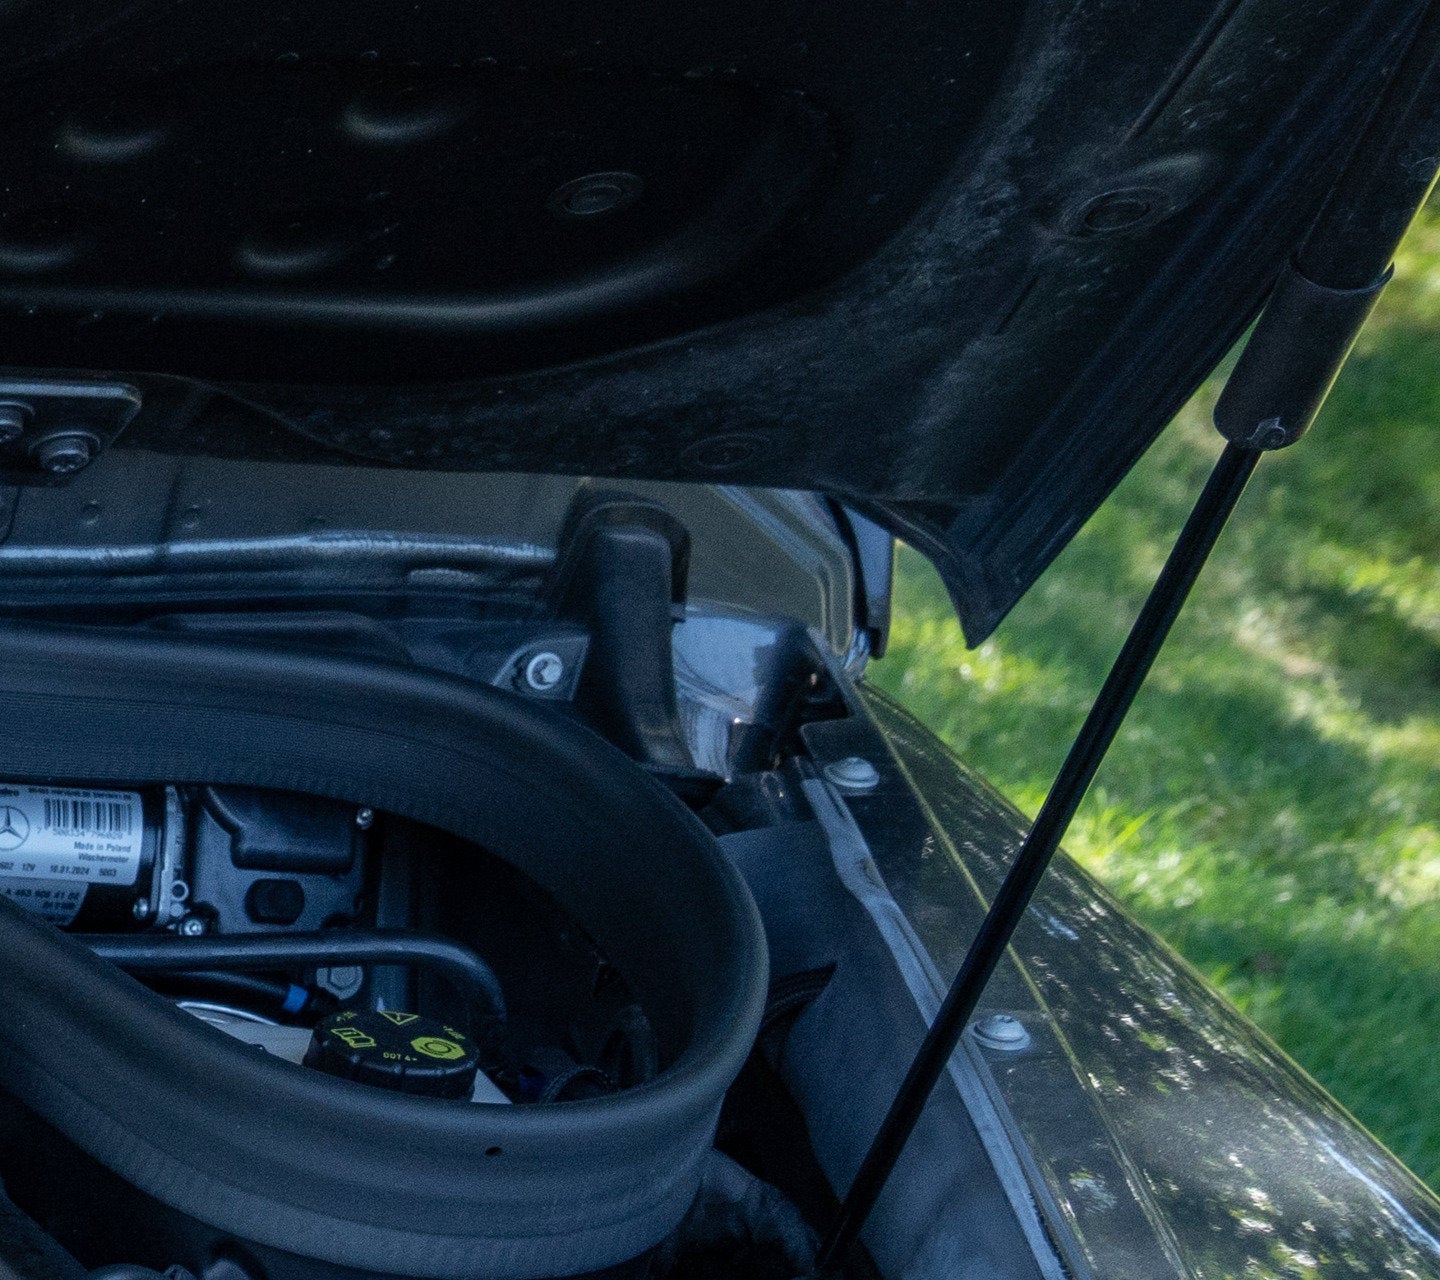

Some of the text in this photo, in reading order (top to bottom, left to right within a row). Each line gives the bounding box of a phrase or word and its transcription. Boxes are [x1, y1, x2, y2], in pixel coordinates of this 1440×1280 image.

[74, 841, 132, 853] Made in Poland
